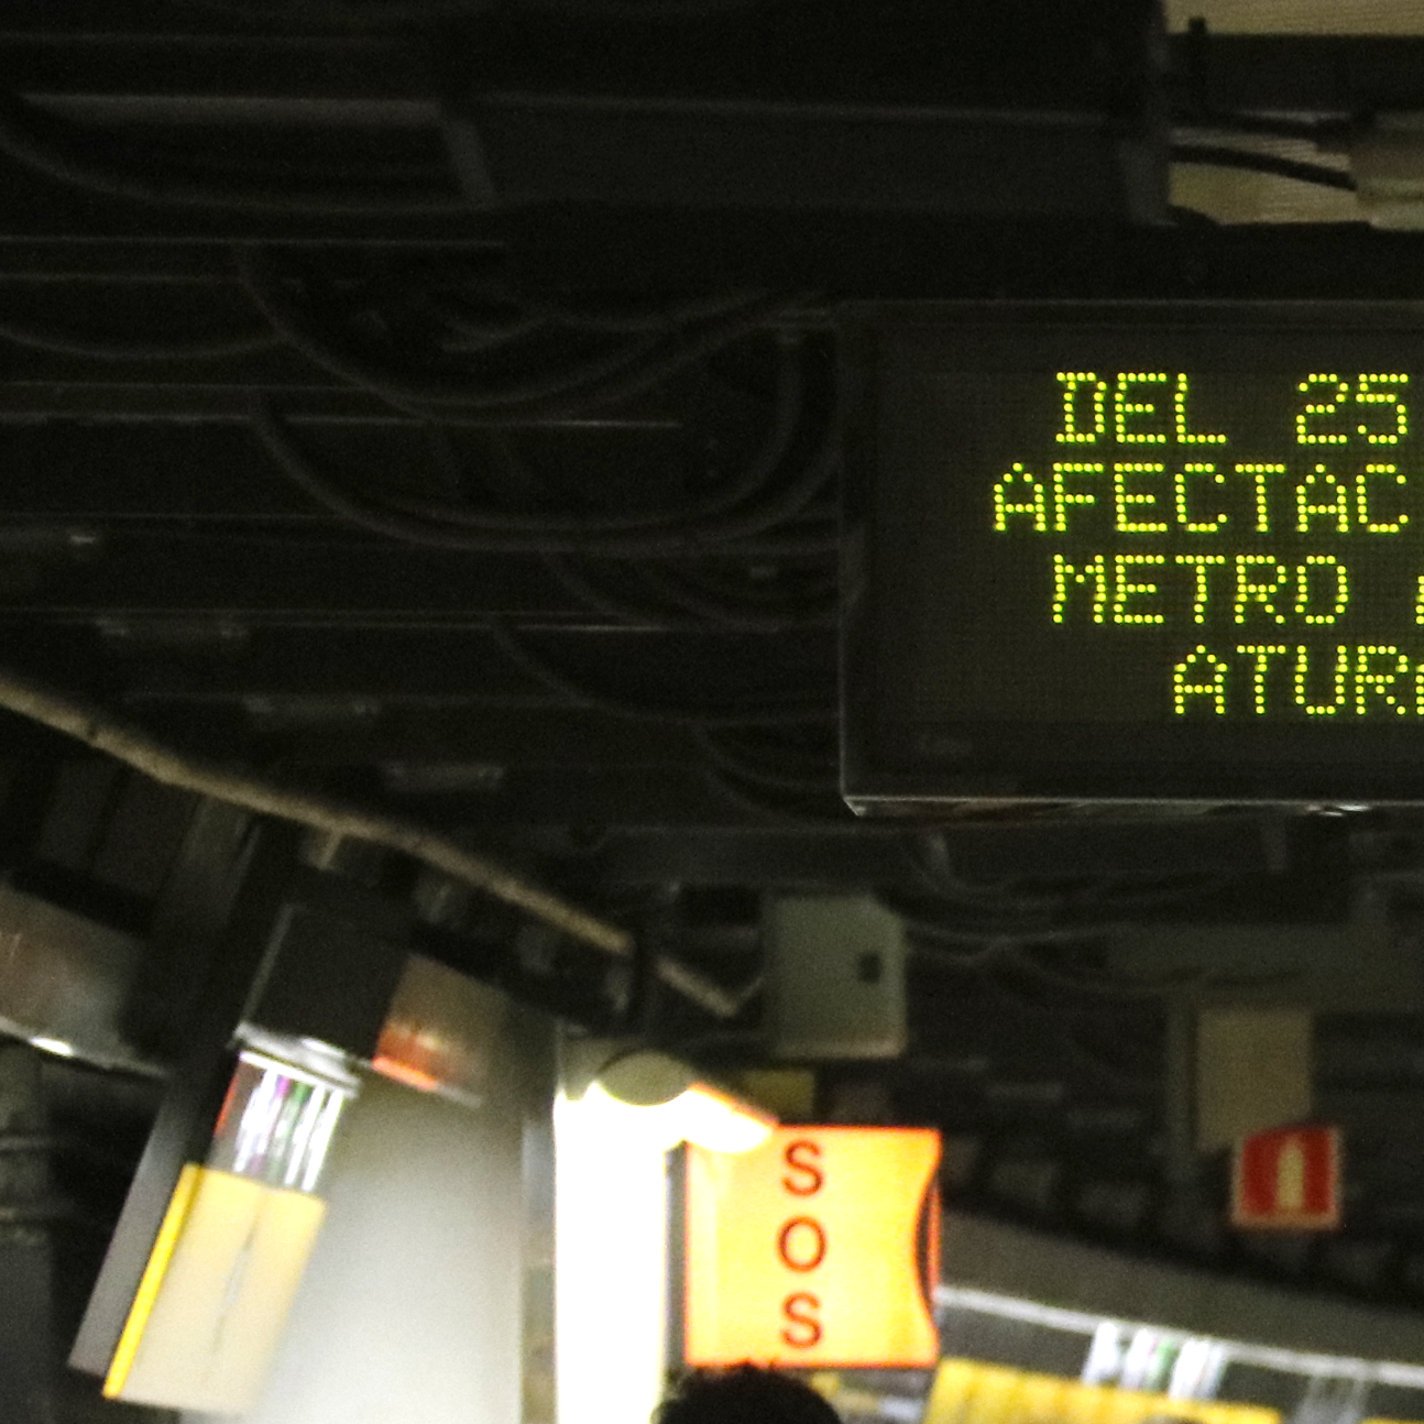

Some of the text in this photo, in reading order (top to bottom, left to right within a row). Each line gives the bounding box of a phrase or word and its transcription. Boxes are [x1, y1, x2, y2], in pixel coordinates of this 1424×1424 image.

[1053, 371, 1230, 446] DEL
[1294, 372, 1410, 447] 25
[1051, 553, 1351, 626] METRO
[776, 1139, 828, 1350] SOS
